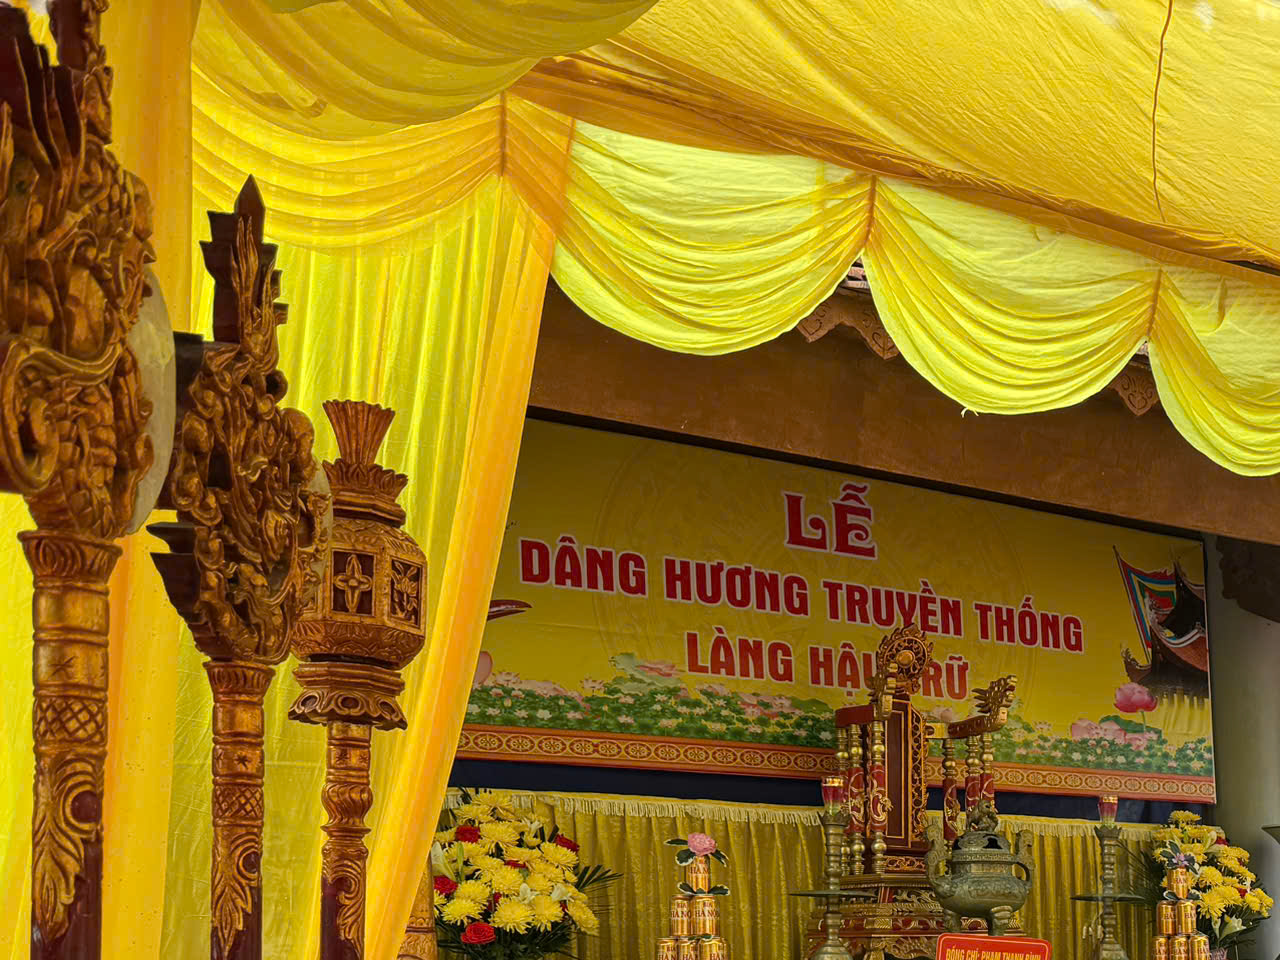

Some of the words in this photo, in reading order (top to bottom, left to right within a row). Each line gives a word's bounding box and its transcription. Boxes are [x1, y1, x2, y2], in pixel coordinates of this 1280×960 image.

[784, 482, 878, 559] LỄ
[519, 535, 648, 597] DÂNG
[664, 556, 809, 617] HƯƠNG
[822, 579, 963, 637] TRUYỀN
[974, 596, 1084, 653] THỐNG
[686, 626, 794, 683] LÀNG
[921, 655, 969, 700] RỮ
